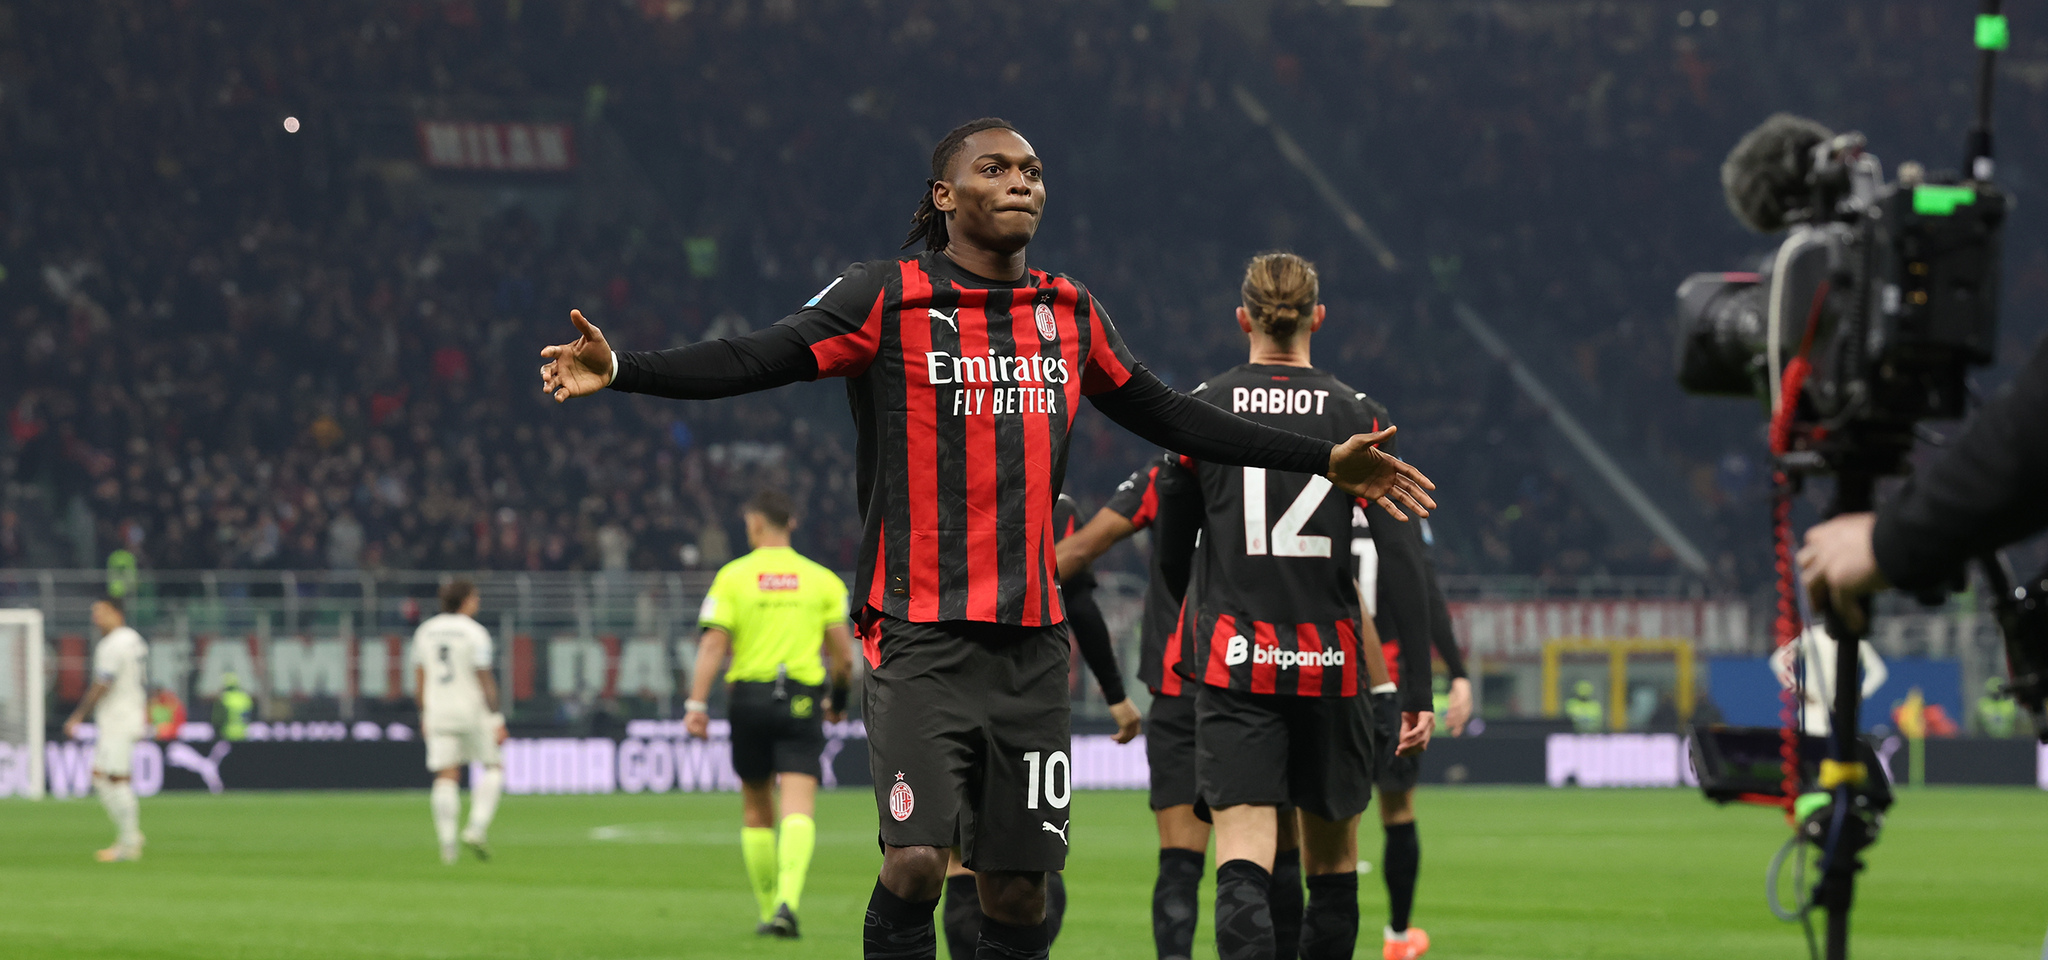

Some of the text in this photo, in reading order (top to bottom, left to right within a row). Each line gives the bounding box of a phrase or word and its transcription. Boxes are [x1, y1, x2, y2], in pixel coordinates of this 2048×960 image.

[925, 348, 1069, 385] Emirates
[953, 387, 1057, 416] FLY BETTER
[1232, 386, 1329, 415] RABIOT
[1243, 466, 1332, 558] 12
[1253, 644, 1345, 670] bitpanda
[469, 737, 617, 794] UMA
[1023, 750, 1071, 809] 10
